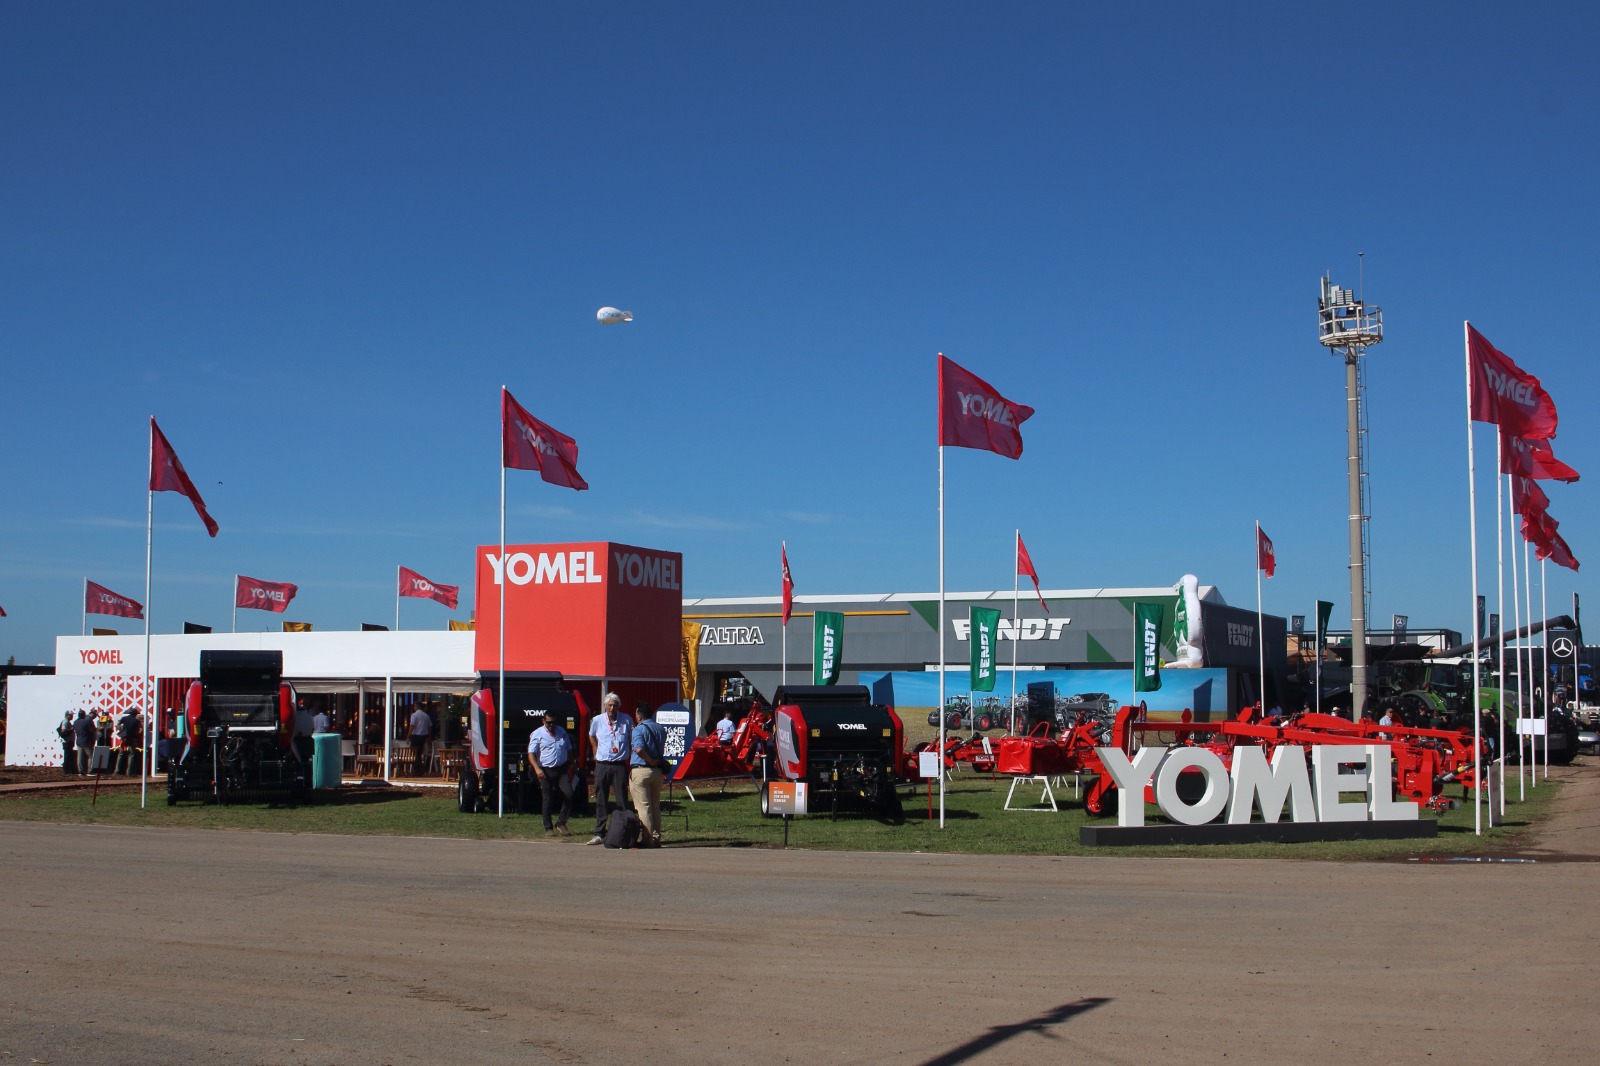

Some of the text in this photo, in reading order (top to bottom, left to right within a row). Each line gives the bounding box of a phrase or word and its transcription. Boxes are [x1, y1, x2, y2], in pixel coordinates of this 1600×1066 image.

[485, 551, 602, 586] YOMEL
[614, 551, 680, 590] YOMEL
[250, 586, 286, 603] YOMEL
[951, 617, 1071, 641] FNDT
[1227, 622, 1254, 647] FENDT
[79, 649, 123, 665] YOMEL
[822, 624, 835, 680] FENDT
[979, 621, 991, 679] FENDT
[1144, 618, 1156, 678] FENDT
[523, 709, 548, 717] YOM
[1093, 744, 1419, 828] YOMEL
